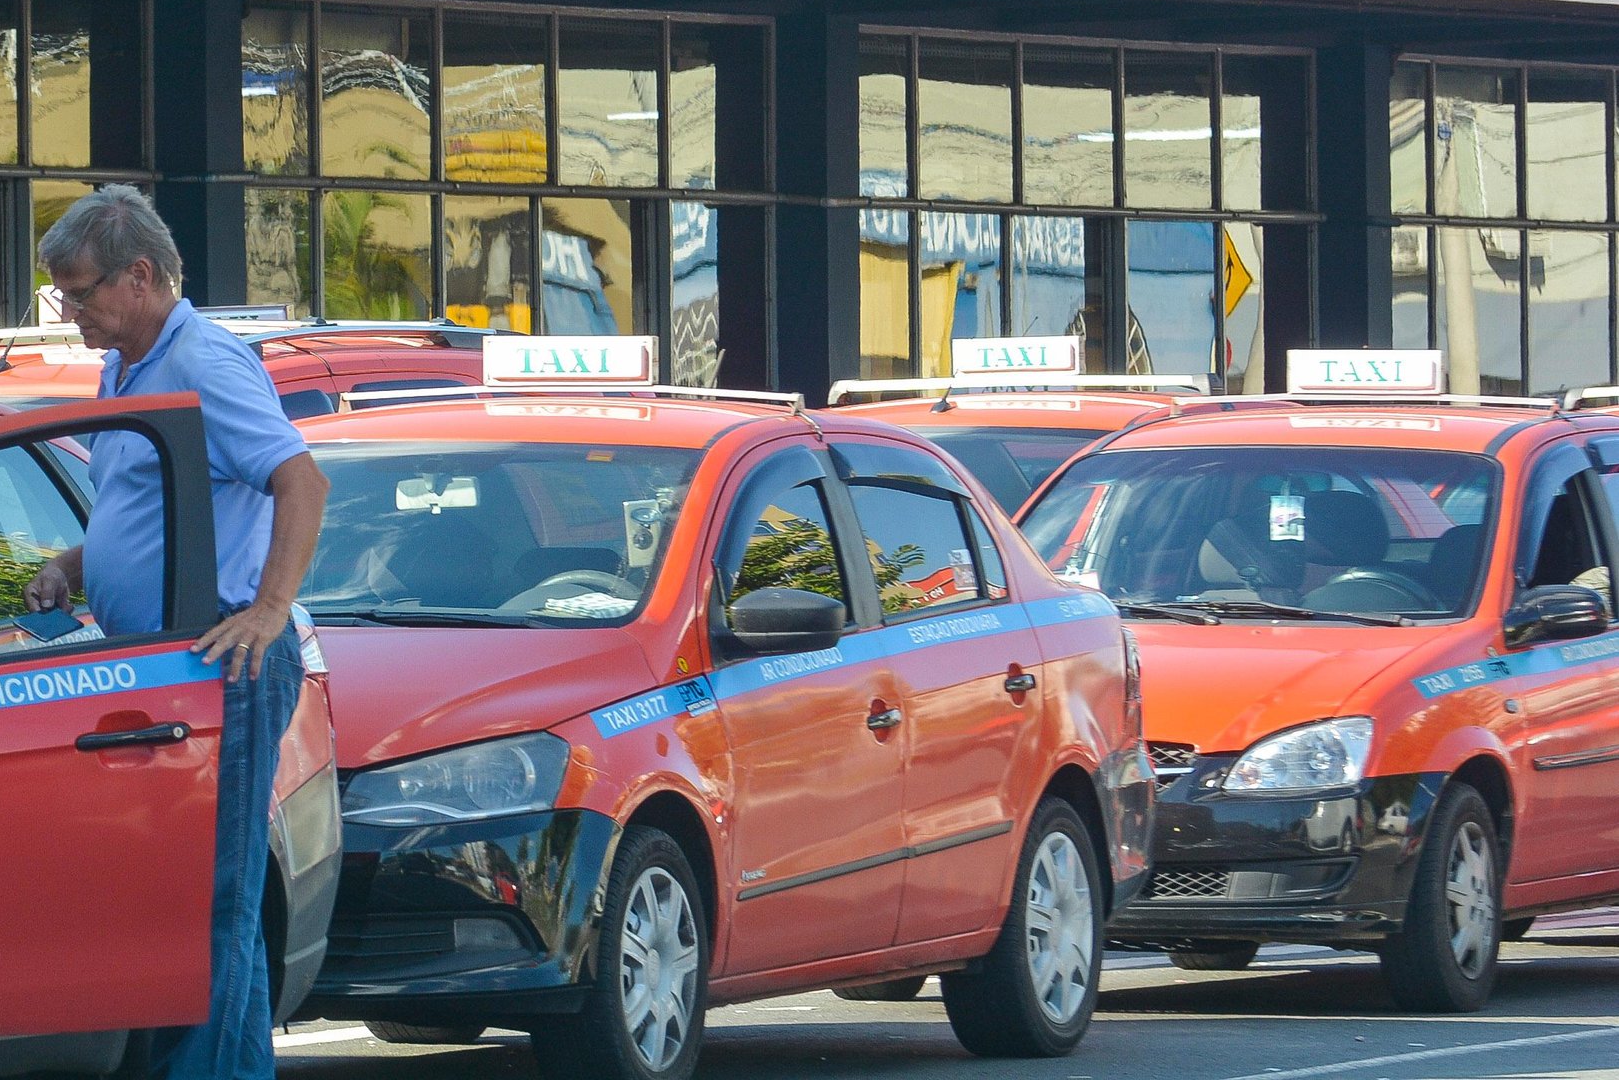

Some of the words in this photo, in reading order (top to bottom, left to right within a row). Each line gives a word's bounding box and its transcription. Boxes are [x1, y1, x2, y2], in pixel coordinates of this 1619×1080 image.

[516, 348, 611, 373] TAXI
[974, 346, 1047, 367] TAXI
[1319, 360, 1402, 382] TAXI
[602, 705, 640, 730] TAXI
[636, 694, 668, 719] 3177
